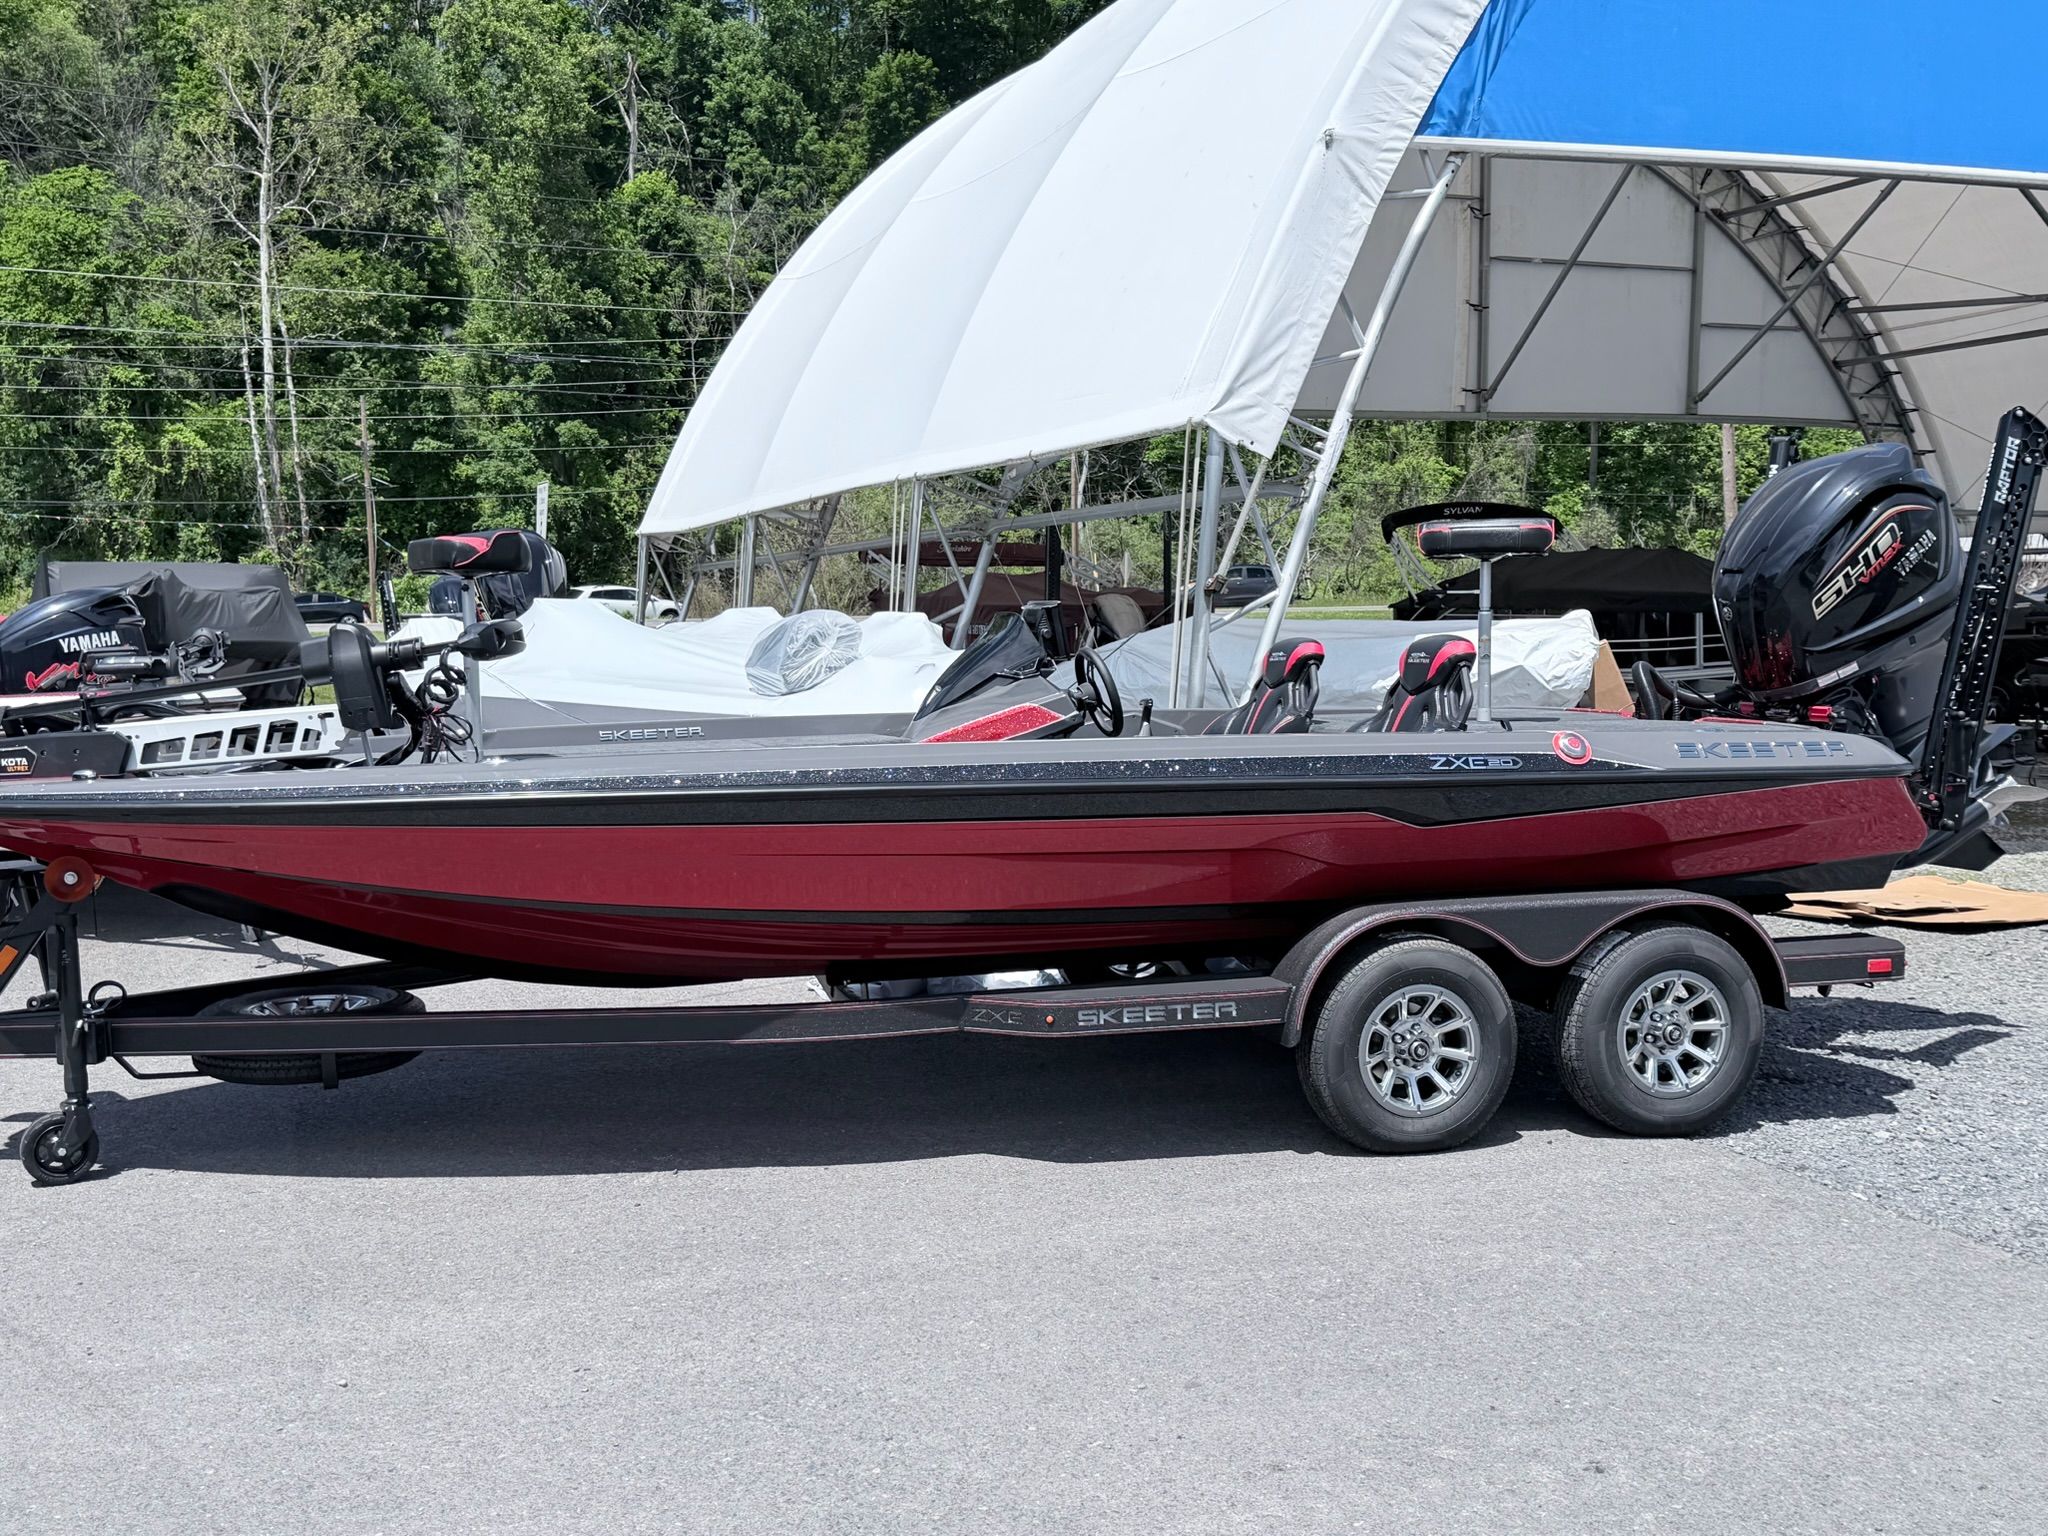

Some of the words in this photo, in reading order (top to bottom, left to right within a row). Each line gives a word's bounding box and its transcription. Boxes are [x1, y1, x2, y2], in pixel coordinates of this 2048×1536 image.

[1994, 436, 2021, 504] RAPTOR
[1443, 506, 1483, 516] SYLVAN
[1893, 529, 1937, 577] YAMAHA
[1812, 522, 1901, 620] SHO
[59, 630, 121, 653] YAMAHA
[599, 726, 705, 741] SKEETER
[1674, 741, 1854, 759] SKEETER
[1, 757, 28, 767] KOTA
[1077, 1001, 1238, 1026] SKEETER
